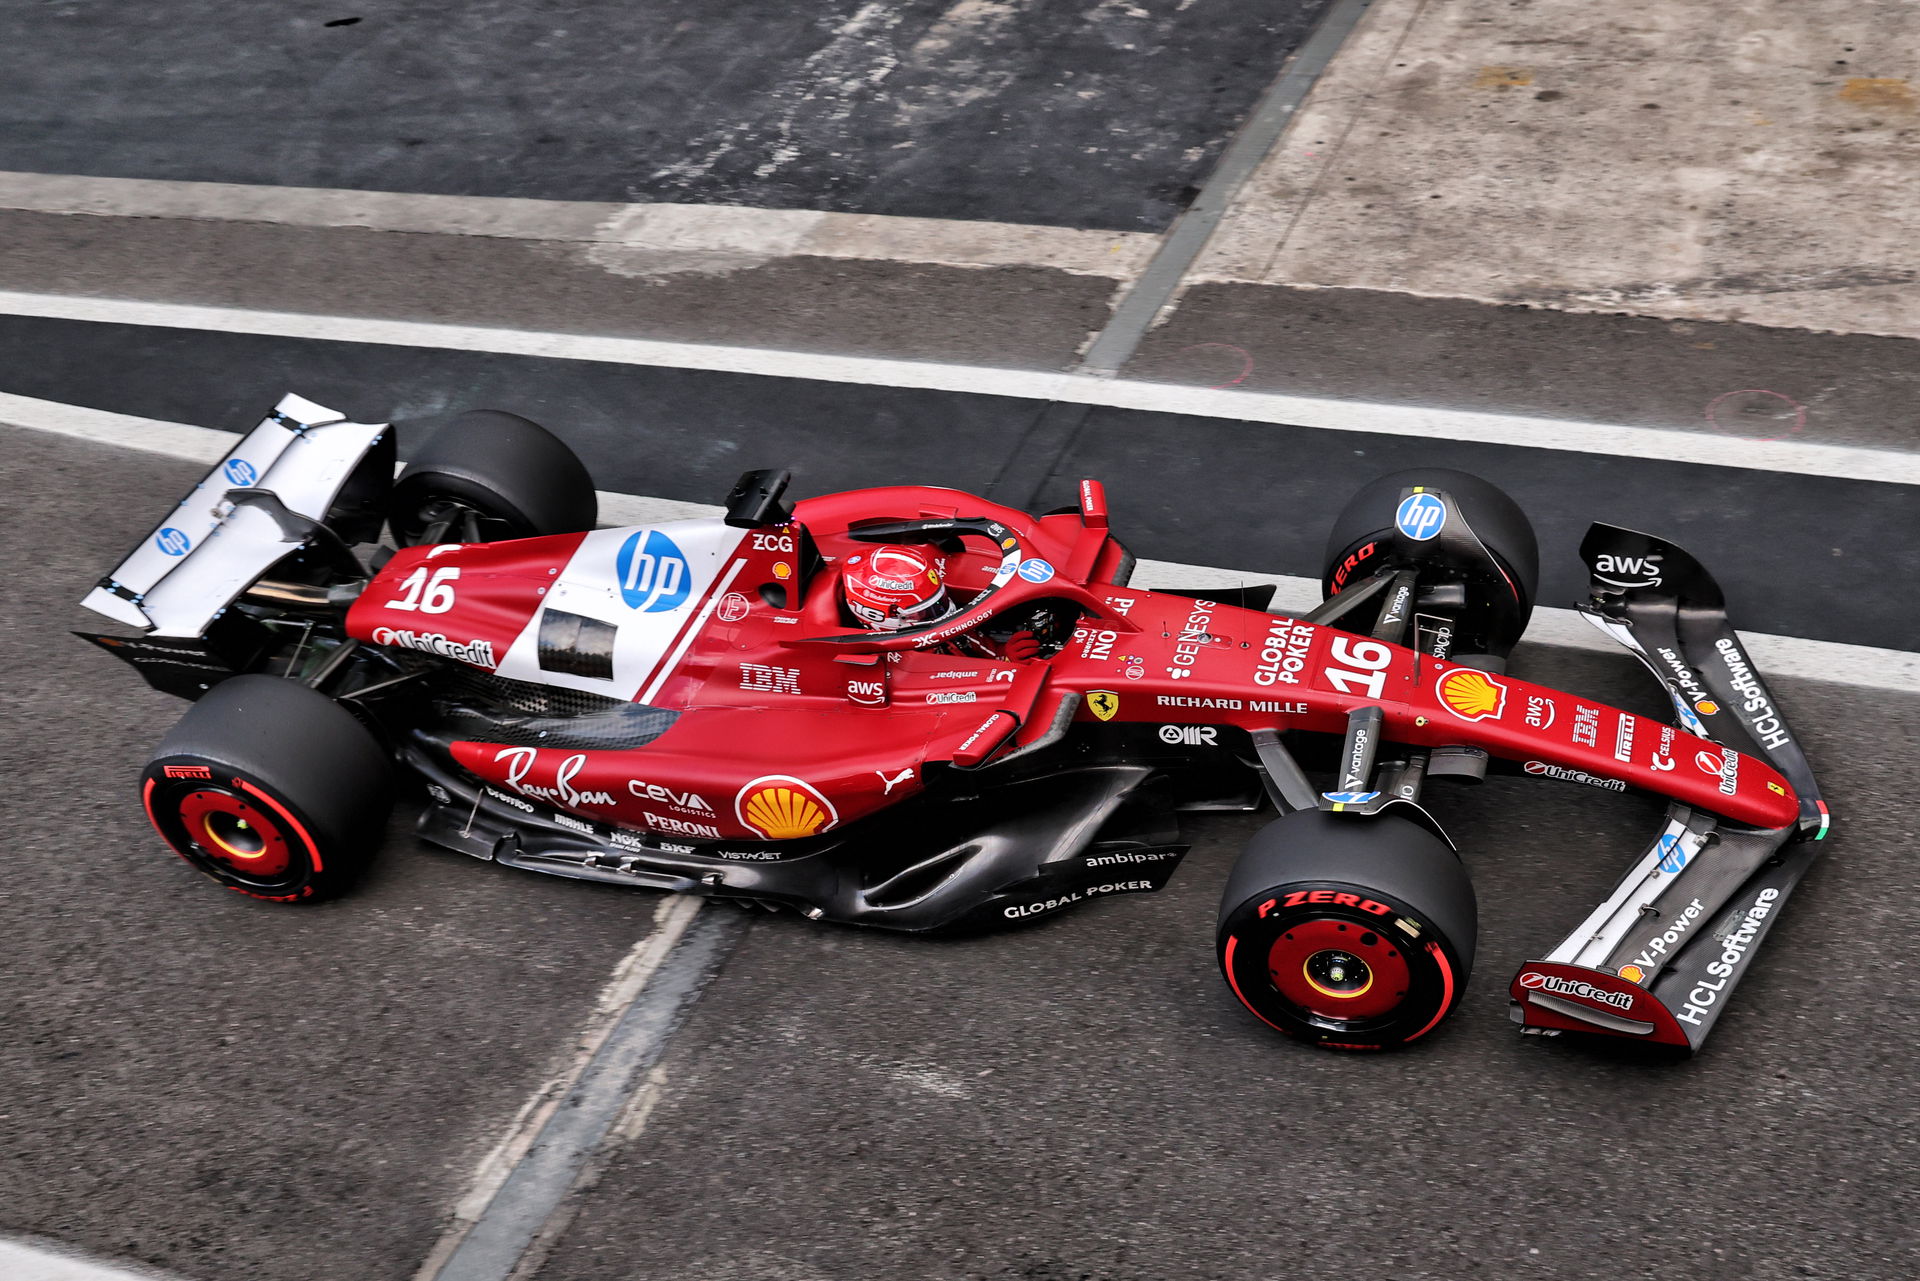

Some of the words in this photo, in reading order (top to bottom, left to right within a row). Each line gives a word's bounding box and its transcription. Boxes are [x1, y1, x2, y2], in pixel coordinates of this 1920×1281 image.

[1401, 493, 1443, 541] hp
[752, 533, 793, 553] ZCG
[624, 530, 685, 613] hp
[1595, 553, 1661, 577] aws
[385, 567, 460, 615] 16
[876, 577, 915, 592] UniCredit
[1390, 586, 1410, 616] vantage
[940, 608, 994, 638] TECHNOLOGY
[1173, 599, 1217, 666] GENESYS
[398, 627, 497, 669] UniCredit
[1253, 617, 1294, 687] GLOBAL
[1280, 625, 1315, 685] POKER
[738, 664, 801, 695] IBM
[1323, 635, 1393, 701] 16
[1657, 647, 1707, 702] V-Power
[847, 681, 884, 698] aws
[936, 692, 976, 704] UniCredit
[1156, 694, 1243, 712] RICHARD
[1250, 699, 1309, 715] MILLE
[1524, 696, 1545, 727] aws
[1572, 704, 1600, 748] IBM
[1350, 728, 1367, 775] vantage
[1614, 712, 1637, 763] PIRELLI
[1659, 726, 1672, 757] CELSIUS
[164, 765, 212, 780] PIRELLI
[494, 746, 617, 809] Ray-Ban
[1546, 765, 1626, 793] UniCredit
[1718, 747, 1739, 796] UniCredit
[553, 813, 595, 835] MAHLE
[643, 811, 721, 839] PERONI
[668, 804, 718, 820] LOGISTICS
[609, 831, 642, 848] NGK
[1086, 851, 1167, 869] ambipar
[1003, 892, 1082, 919] GLOBAL
[1086, 880, 1152, 897] POKER
[1257, 898, 1277, 919] P
[1284, 890, 1393, 916] ZERO
[1634, 898, 1706, 970] V-Power
[1543, 975, 1634, 1011] UniCredit
